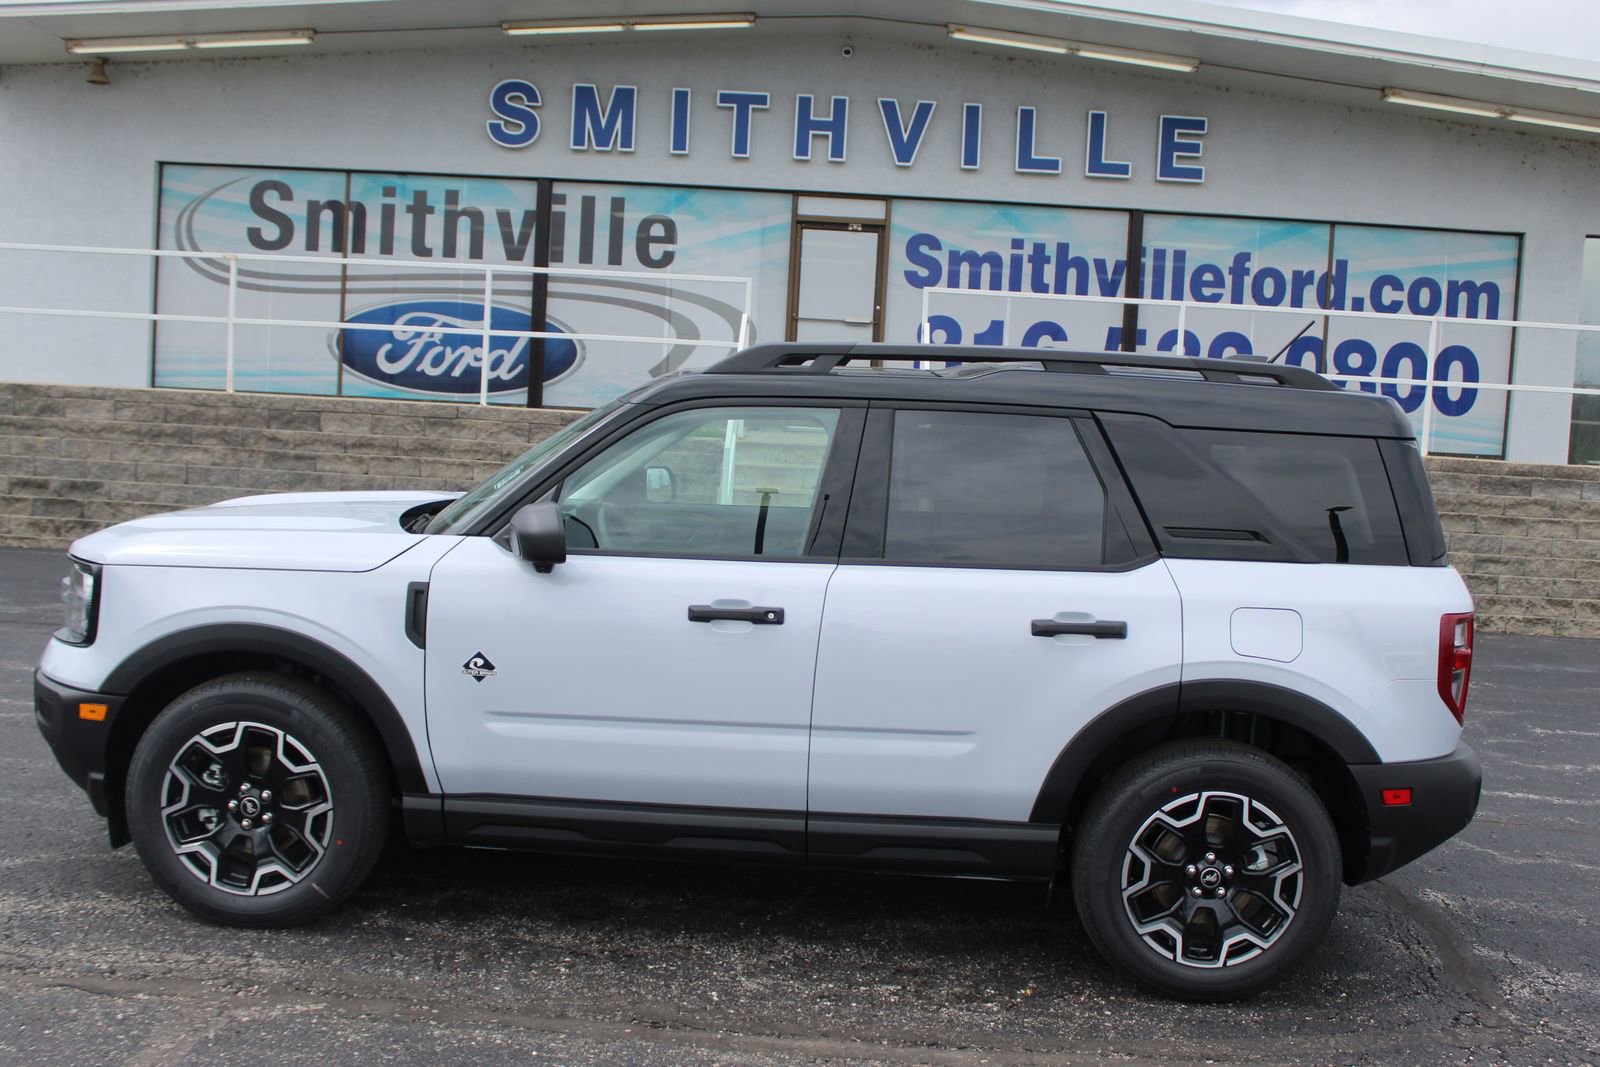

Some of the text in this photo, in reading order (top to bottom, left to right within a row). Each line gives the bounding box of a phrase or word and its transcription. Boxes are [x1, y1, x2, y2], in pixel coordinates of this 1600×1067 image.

[486, 79, 1208, 183] SMITHVILLE
[247, 179, 678, 269] Smithville
[376, 312, 530, 381] Ford
